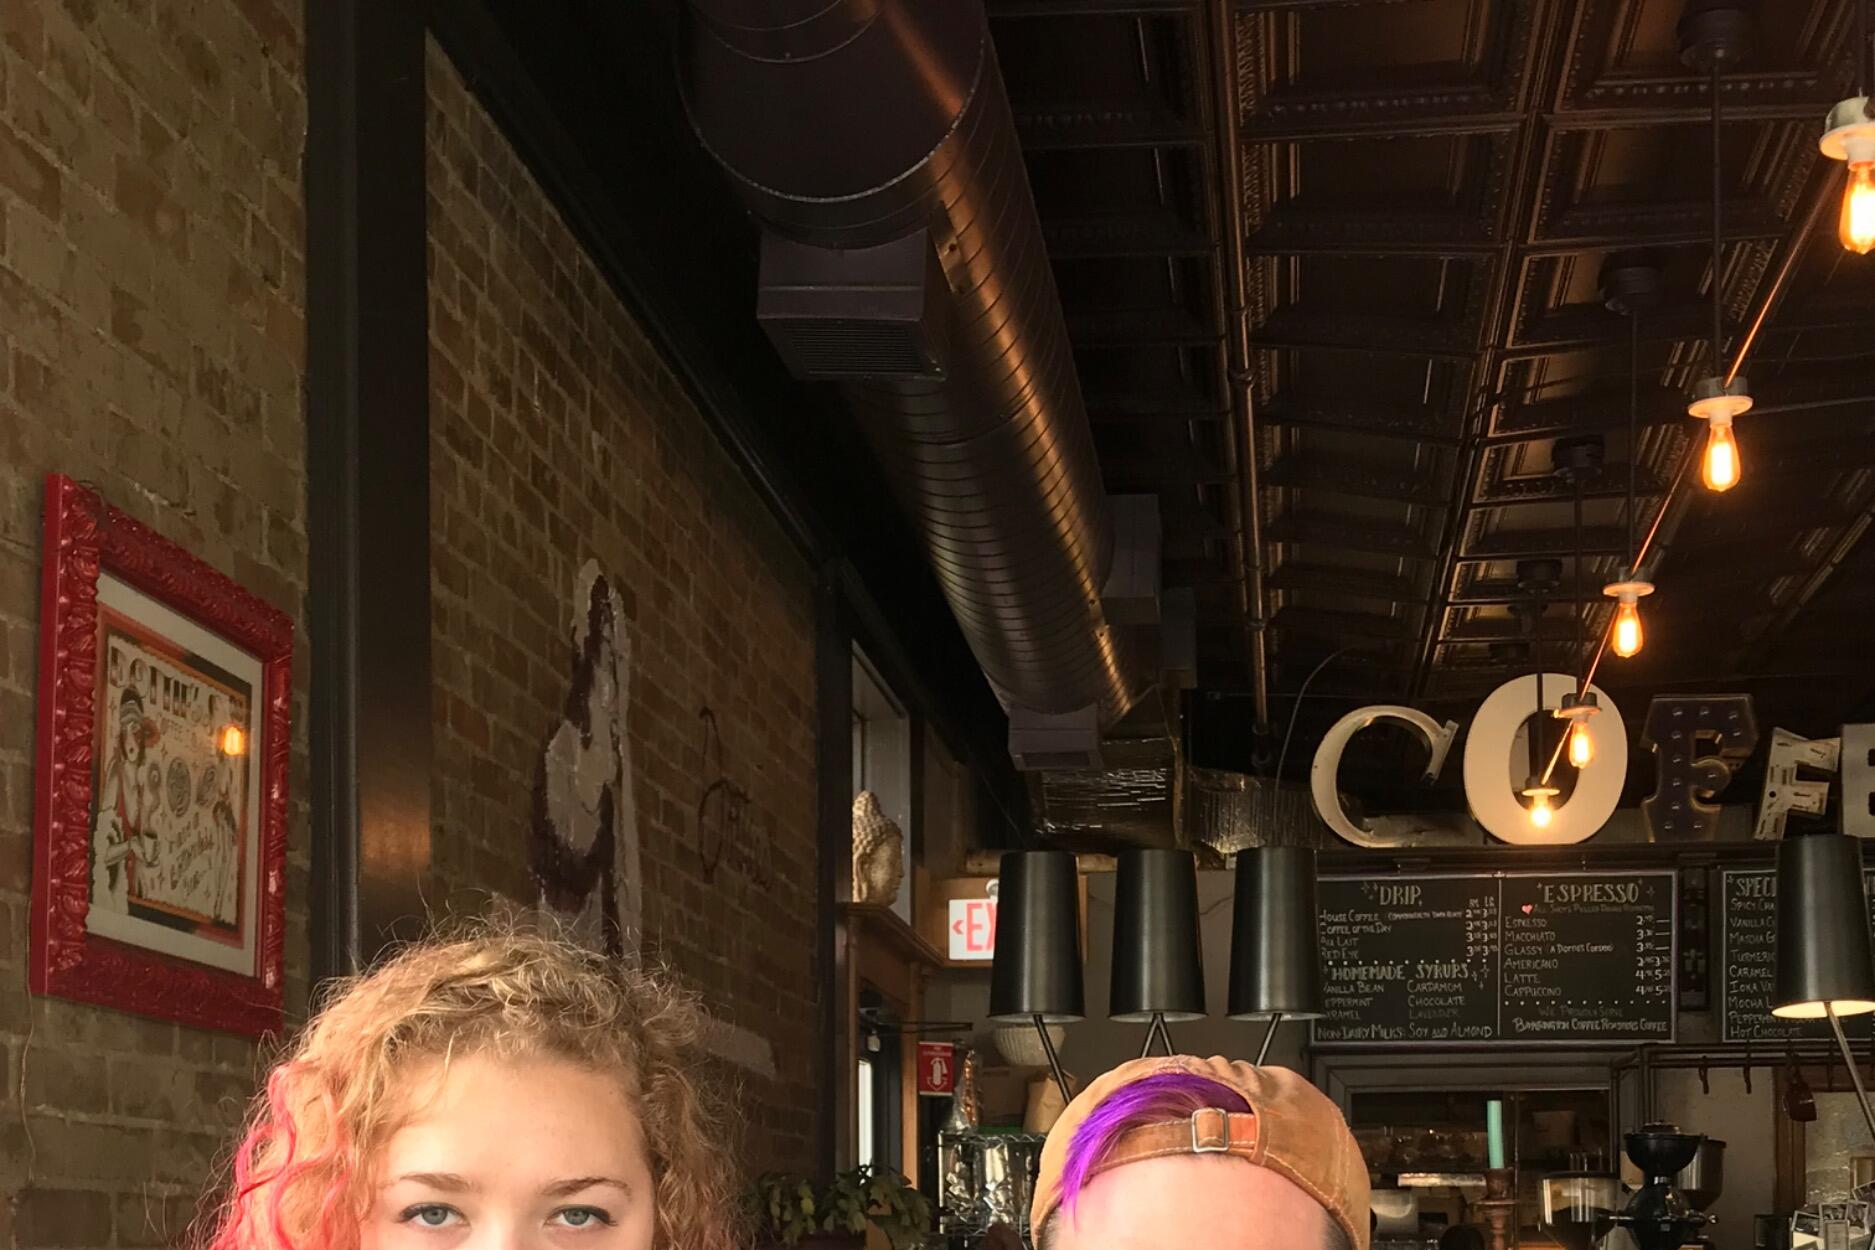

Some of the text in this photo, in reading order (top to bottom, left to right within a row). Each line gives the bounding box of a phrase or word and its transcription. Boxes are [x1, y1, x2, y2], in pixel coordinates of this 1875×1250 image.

[1379, 885, 1422, 906] DRIP
[1543, 882, 1640, 904] ESPRESSO
[1348, 909, 1379, 922] COFFEE
[1504, 916, 1548, 929] ESPRESSO
[1503, 957, 1559, 969] AMERICANO
[1330, 963, 1469, 981] HOMEMADE SYRUPS
[1503, 972, 1541, 984] LATTE
[1503, 985, 1562, 998] CAPPUCCINO
[1324, 994, 1465, 1008] EPPERMINT CHOCOLATE
[1326, 1009, 1361, 1020] ARAMEL
[1450, 1021, 1493, 1039] ALMOND
[1571, 1018, 1600, 1031] COFFEE
[1640, 1018, 1668, 1032] COFFEE
